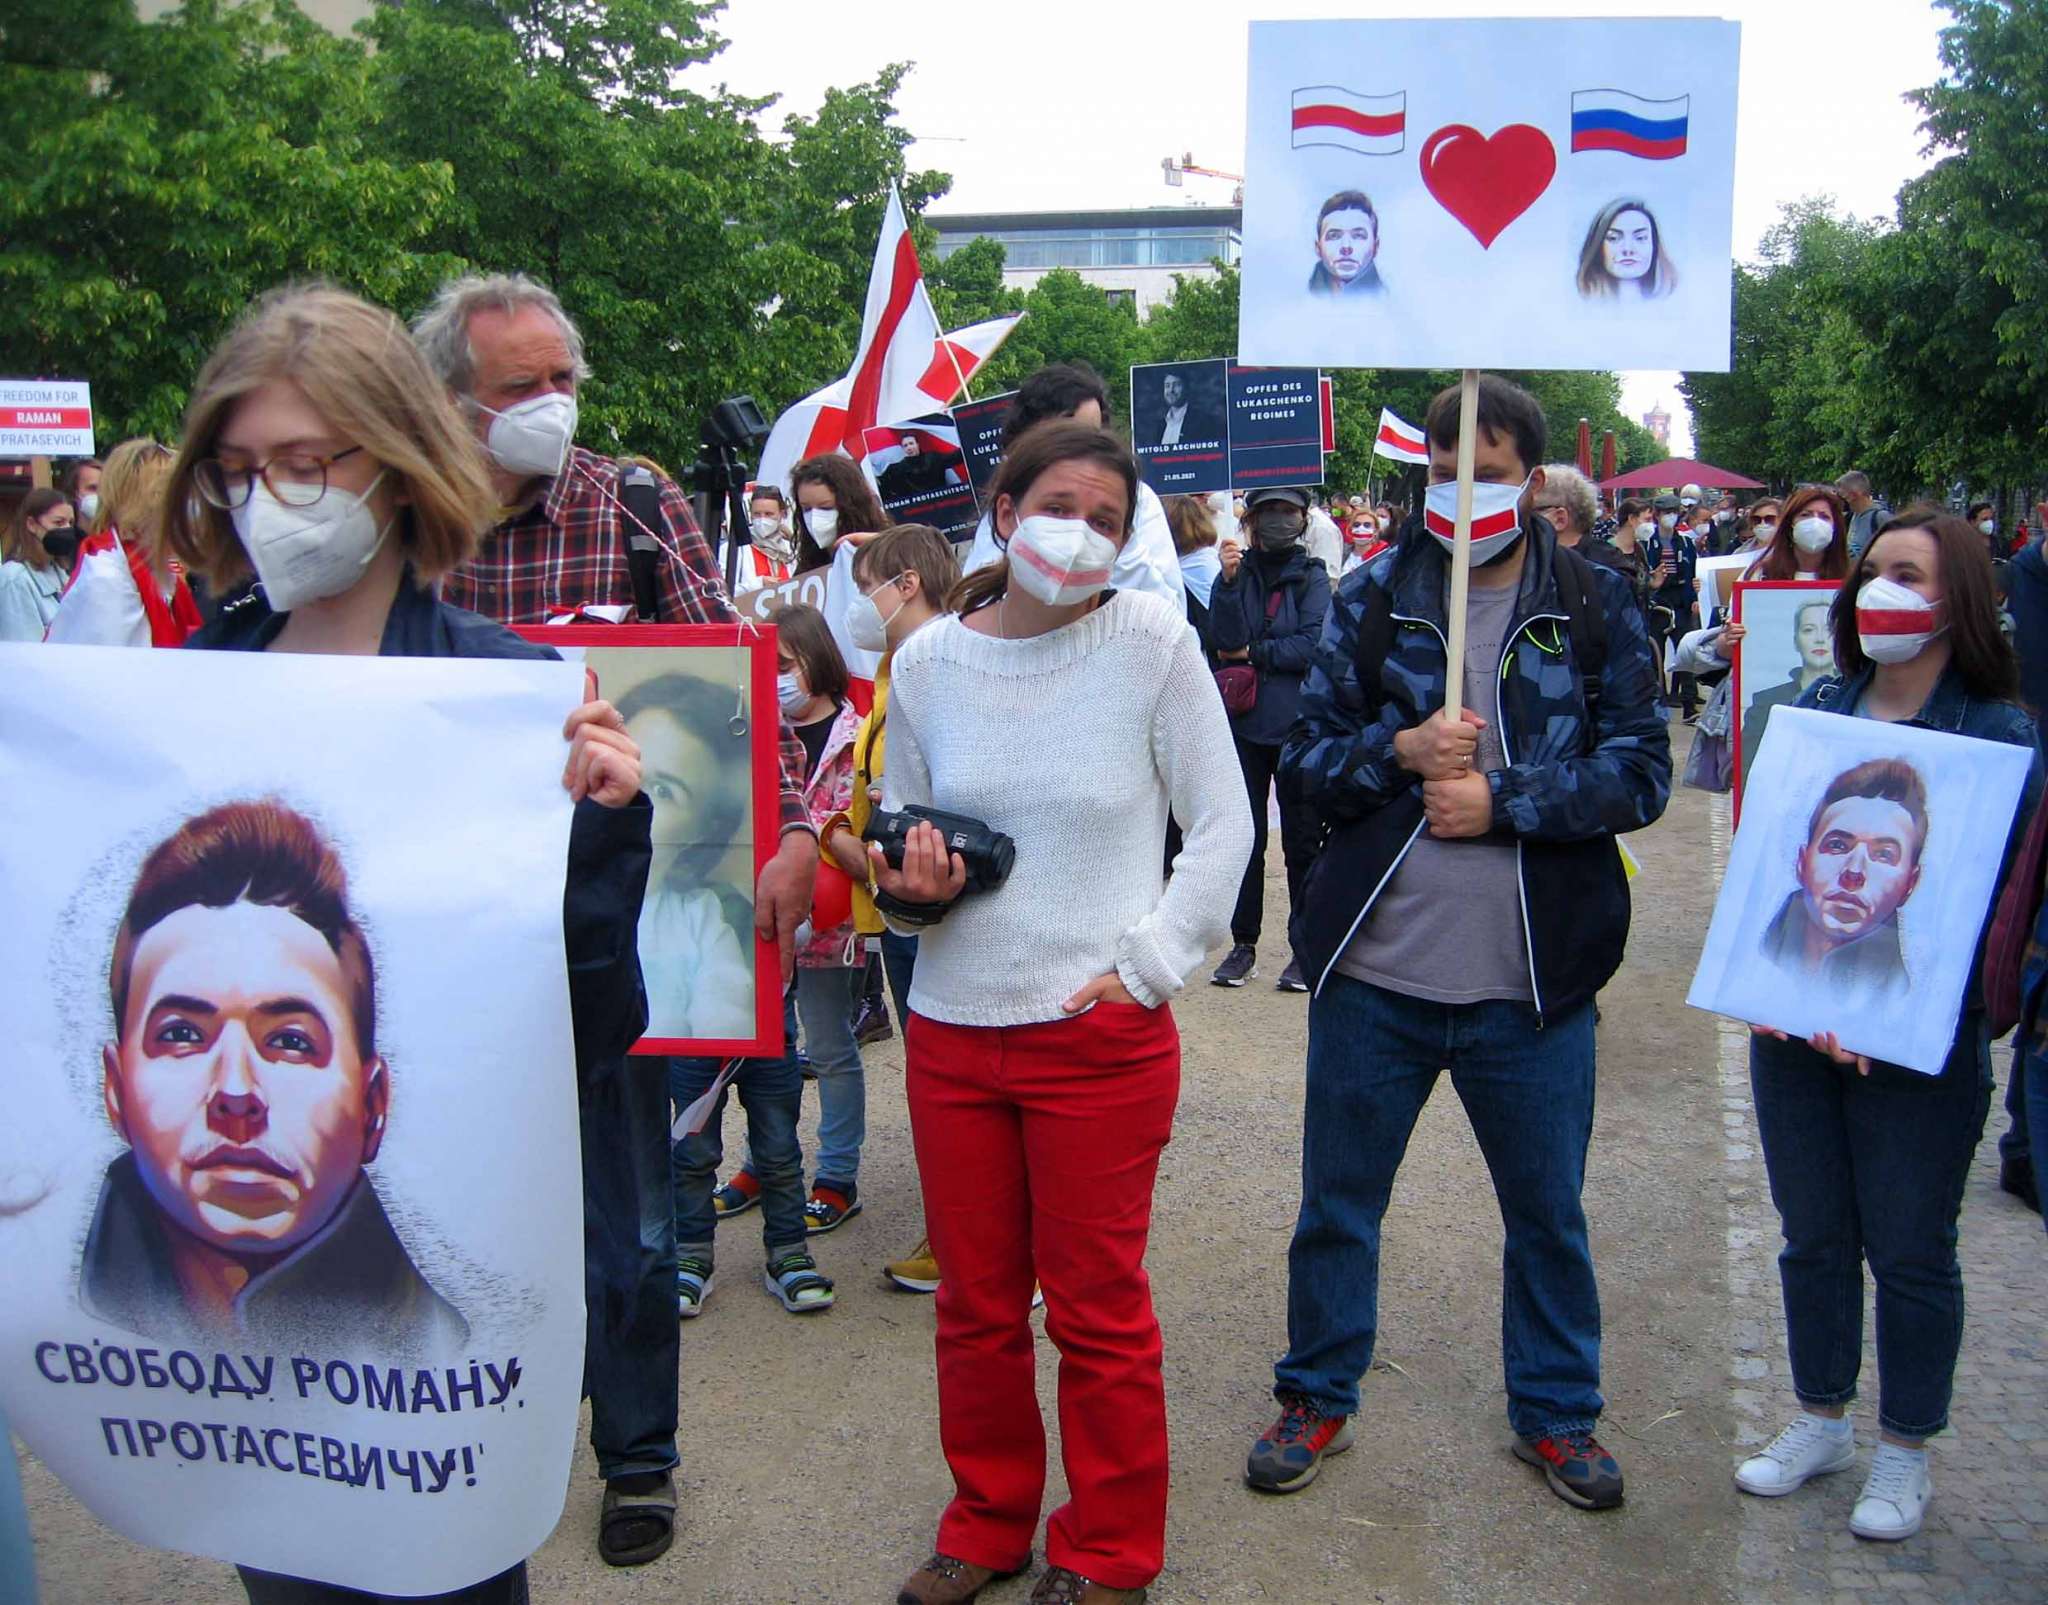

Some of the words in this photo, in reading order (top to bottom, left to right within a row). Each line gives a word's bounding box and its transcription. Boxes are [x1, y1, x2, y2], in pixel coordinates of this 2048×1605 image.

[1245, 384, 1278, 394] OPFER
[1282, 382, 1302, 391] DES
[55, 391, 79, 402] FOR
[1236, 395, 1313, 408] LUKASCHENKO
[16, 411, 62, 424] RAMAN
[1250, 409, 1296, 421] REGIMES
[1, 433, 81, 446] PRATASEVICH
[1136, 445, 1170, 454] WITOLD
[34, 1340, 274, 1400] СВОБОДУ
[100, 1416, 478, 1494] ПРОТАСЕВИЧУ!
